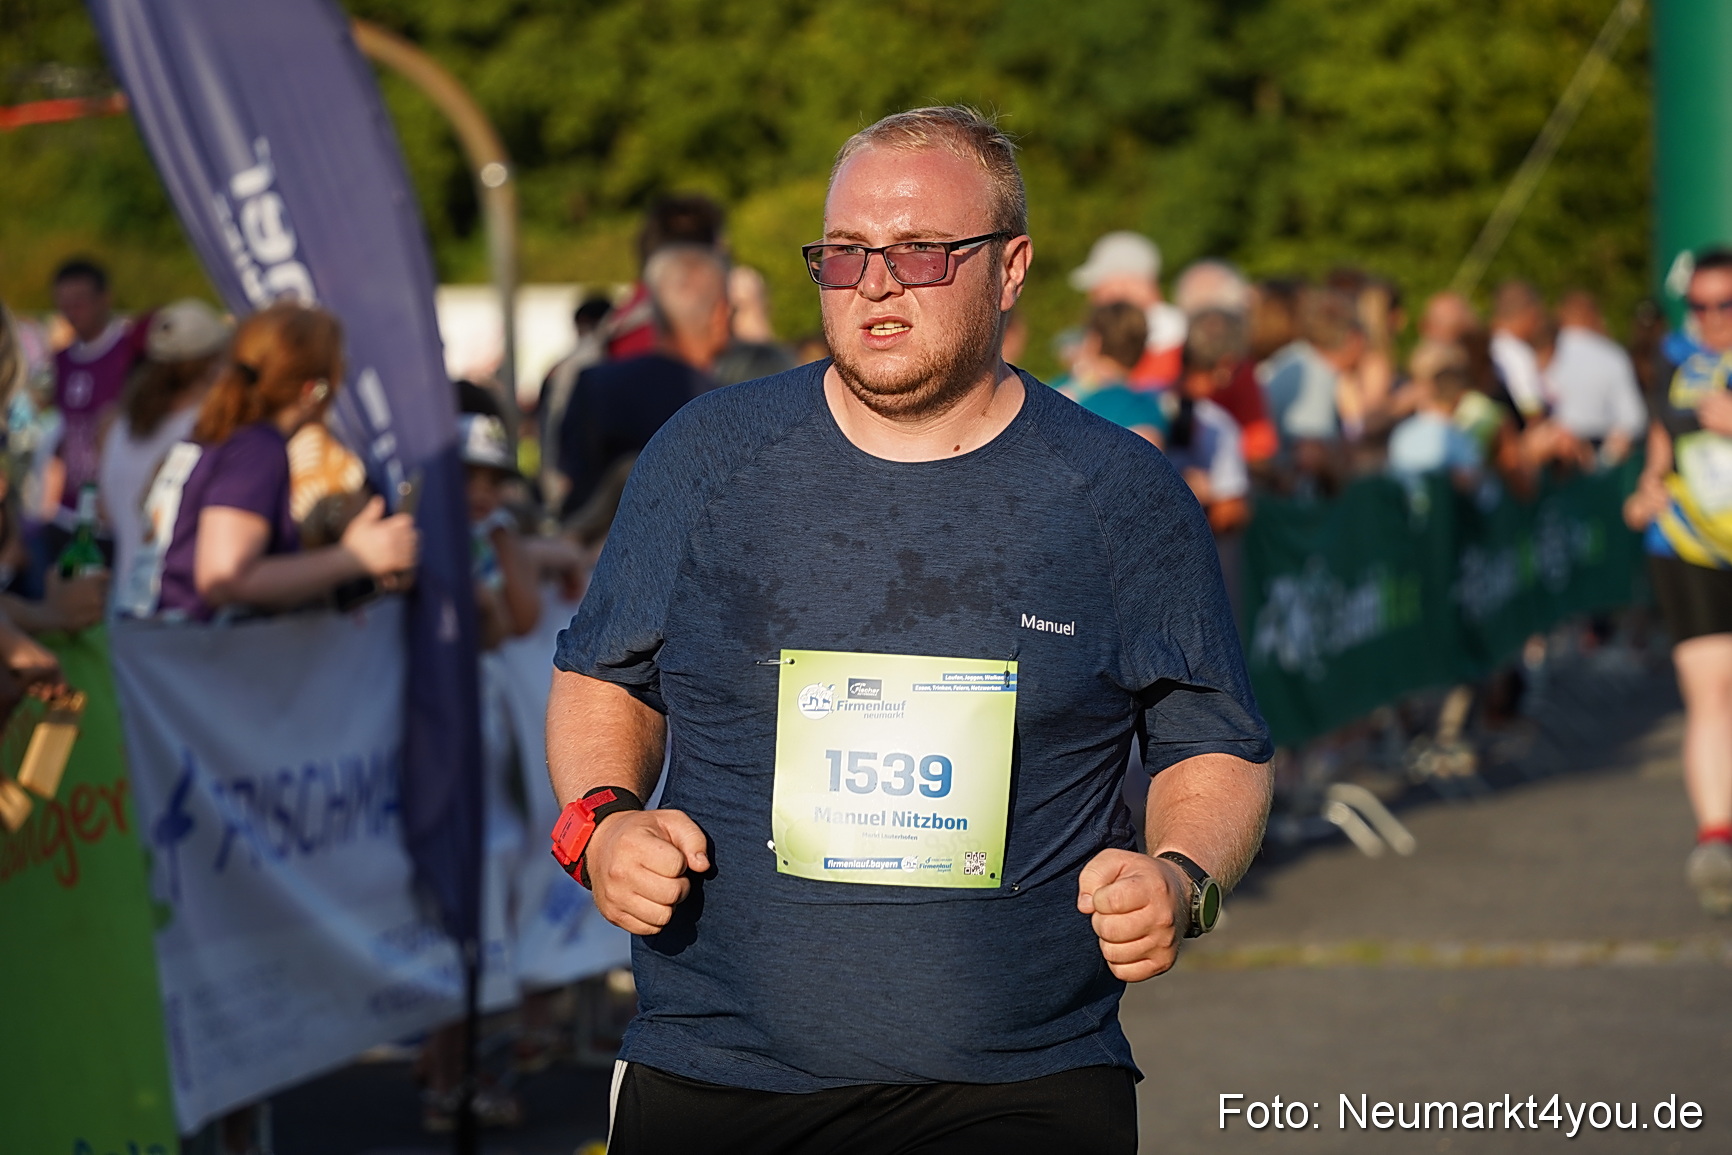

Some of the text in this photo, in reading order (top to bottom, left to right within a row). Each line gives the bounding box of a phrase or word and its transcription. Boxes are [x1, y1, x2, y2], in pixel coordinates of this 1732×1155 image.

[1021, 613, 1075, 636] Manuel
[836, 700, 906, 712] Firmenlauf
[863, 711, 904, 719] neumarkt
[825, 749, 953, 798] 1539
[814, 806, 968, 830] Manuel Nitzbon
[827, 860, 898, 870] firmenlauf.bayern
